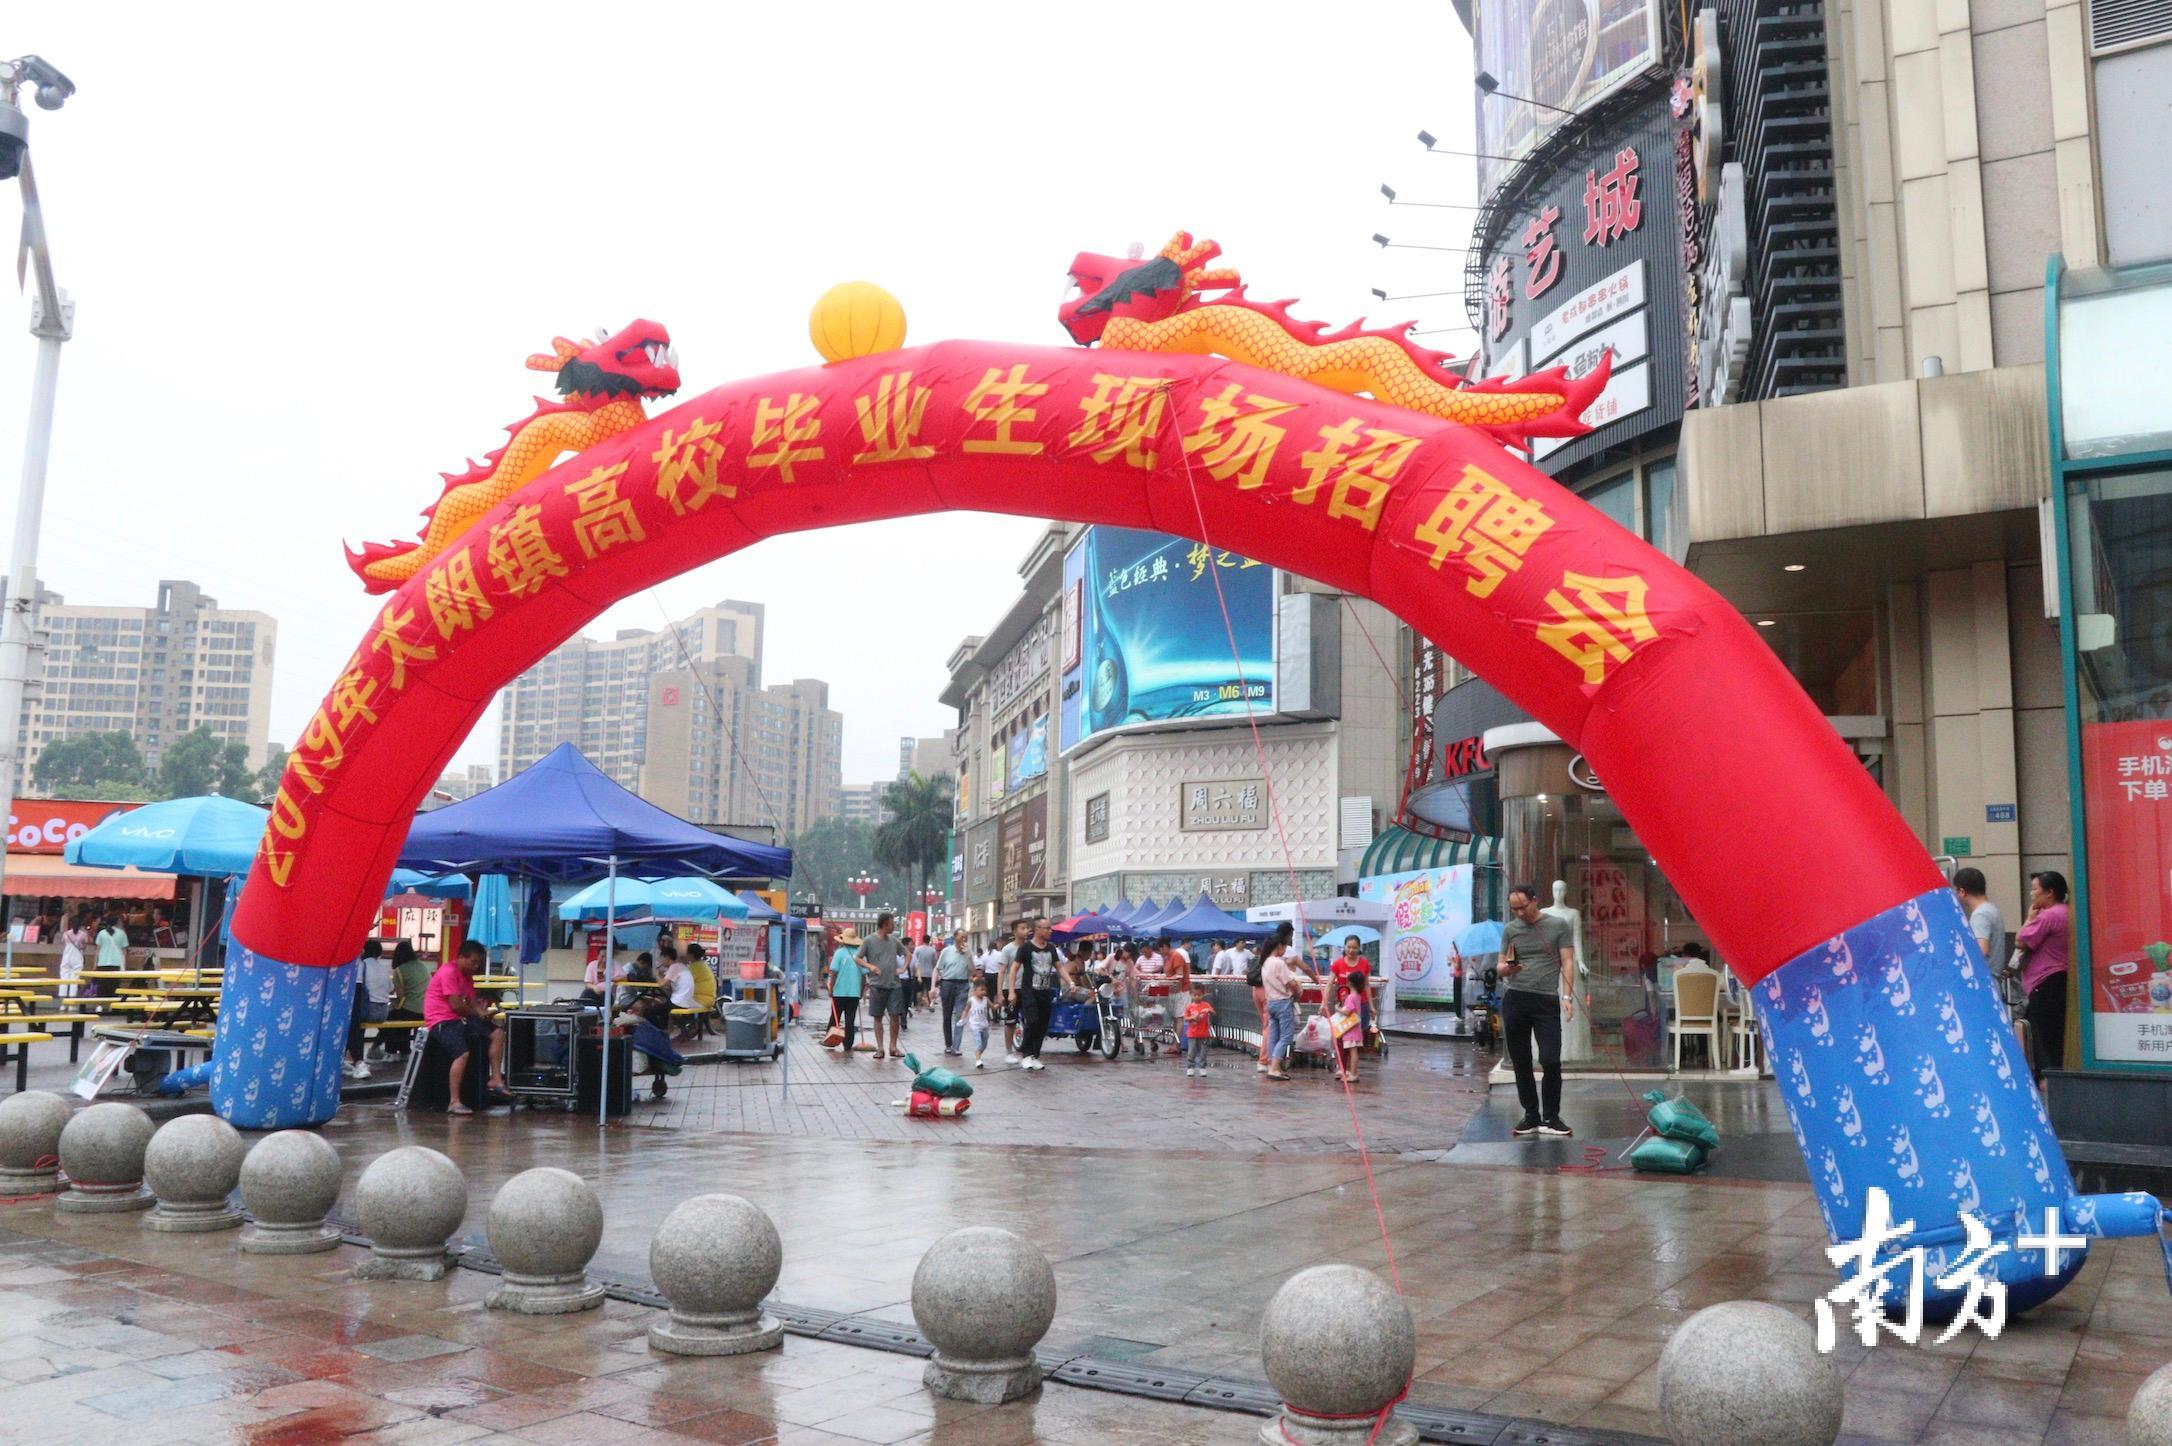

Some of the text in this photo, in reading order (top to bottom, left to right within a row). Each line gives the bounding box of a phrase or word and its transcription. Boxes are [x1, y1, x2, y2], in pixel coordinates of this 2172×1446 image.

[258, 364, 1659, 887] 2019年大朗镇高校毕业生现场招聘会
[1193, 685, 1265, 702] M3 M6 M9
[1445, 736, 1492, 778] KFC
[1190, 785, 1259, 811] 周六福
[1190, 816, 1220, 825] ZHOU
[1241, 814, 1257, 823] FU
[120, 826, 176, 838] vivo
[661, 890, 702, 899] vivo
[1199, 877, 1246, 895] 周六福
